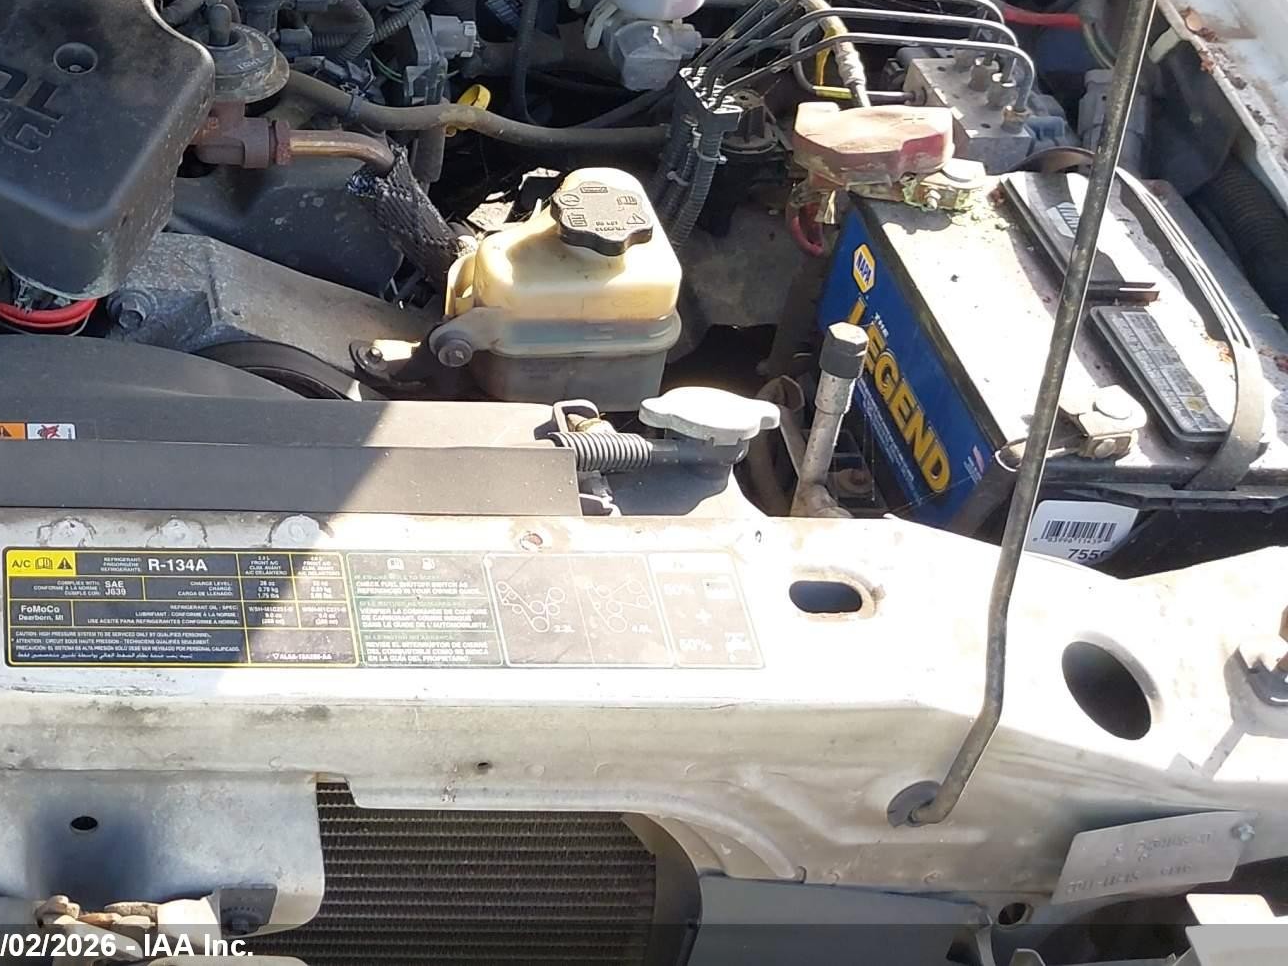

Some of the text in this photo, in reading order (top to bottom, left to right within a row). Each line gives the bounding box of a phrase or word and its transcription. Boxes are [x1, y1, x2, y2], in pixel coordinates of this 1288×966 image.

[856, 251, 872, 284] NAPA
[12, 560, 31, 568] A/C
[148, 559, 208, 571] R-134A
[20, 605, 60, 613] FoMoCo
